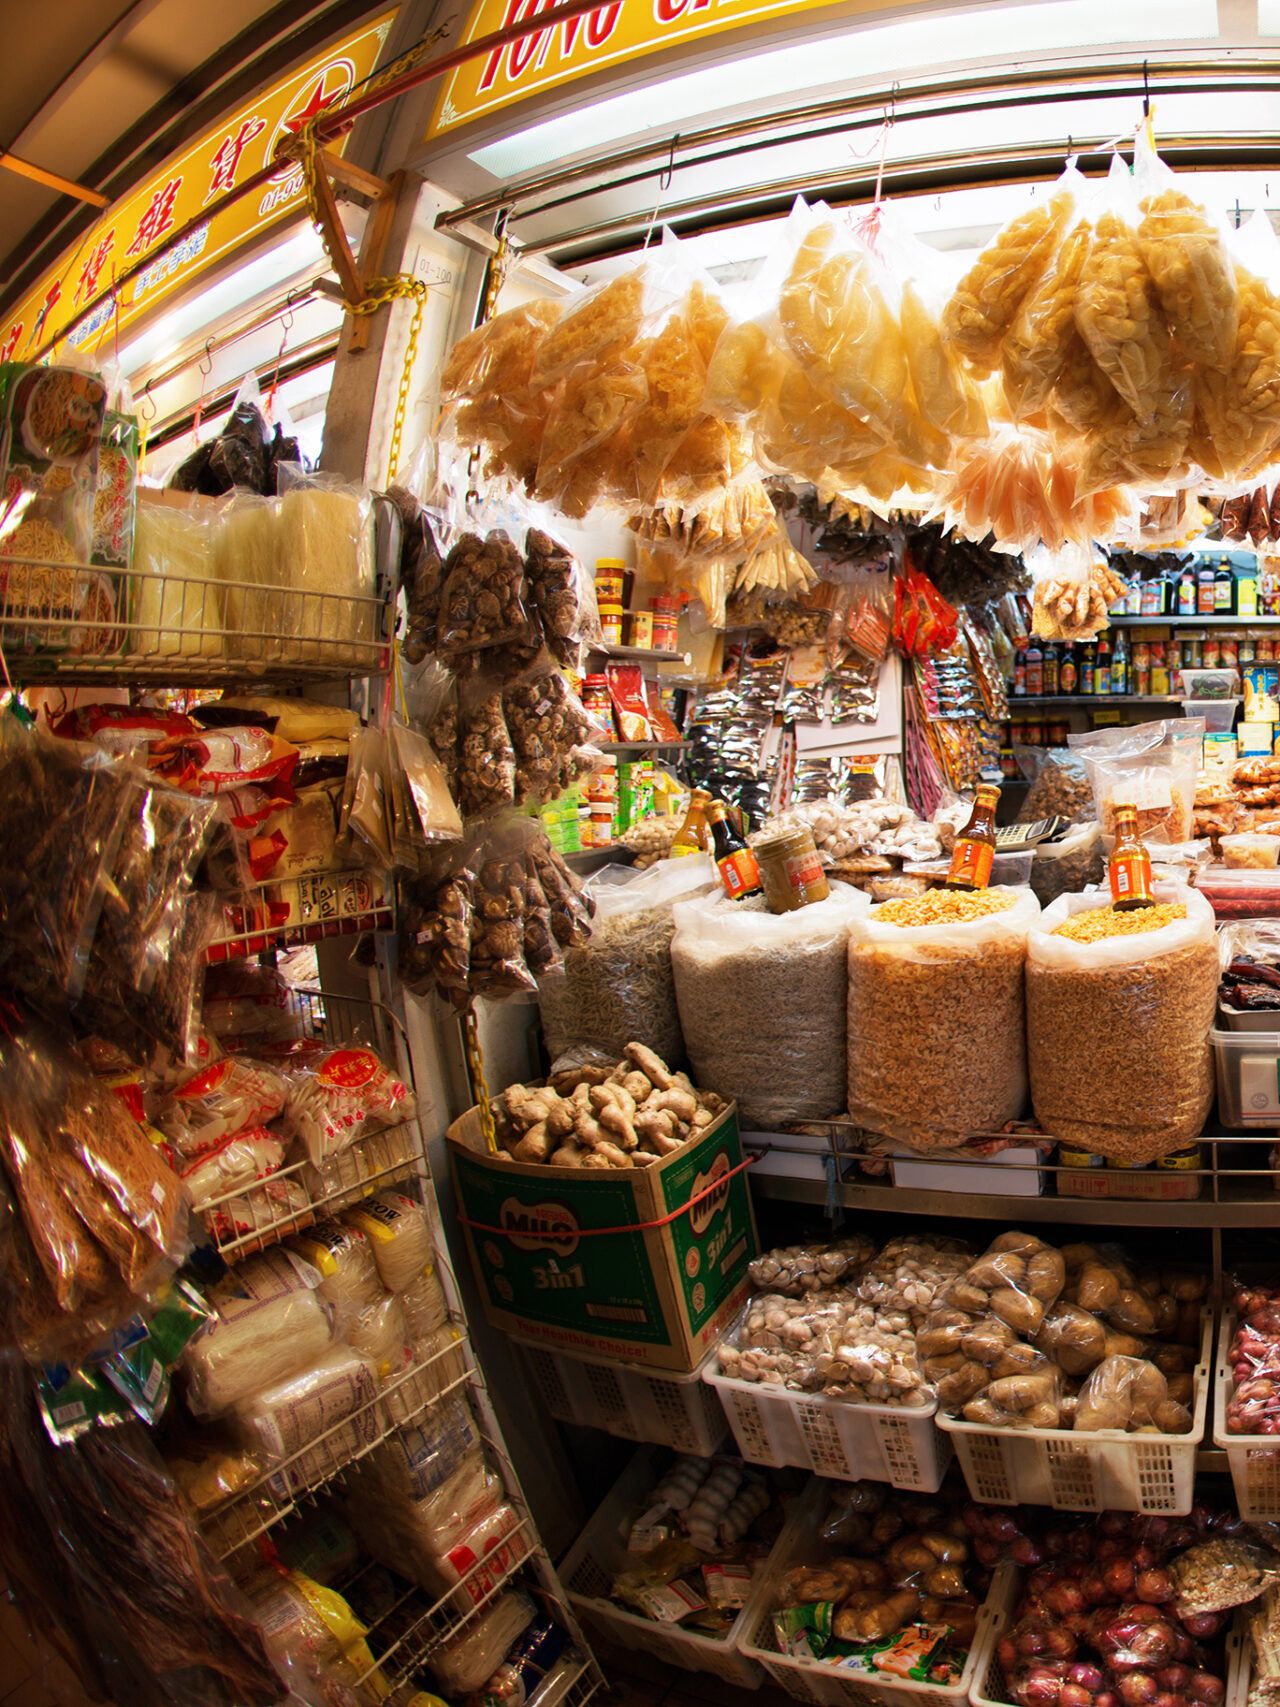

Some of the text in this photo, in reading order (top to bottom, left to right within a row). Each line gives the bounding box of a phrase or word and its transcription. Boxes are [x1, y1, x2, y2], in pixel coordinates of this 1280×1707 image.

[420, 258, 453, 284] 01-100
[505, 1210, 574, 1246] MILO
[543, 1323, 597, 1347] Healthier
[598, 1338, 648, 1359] Choice!
